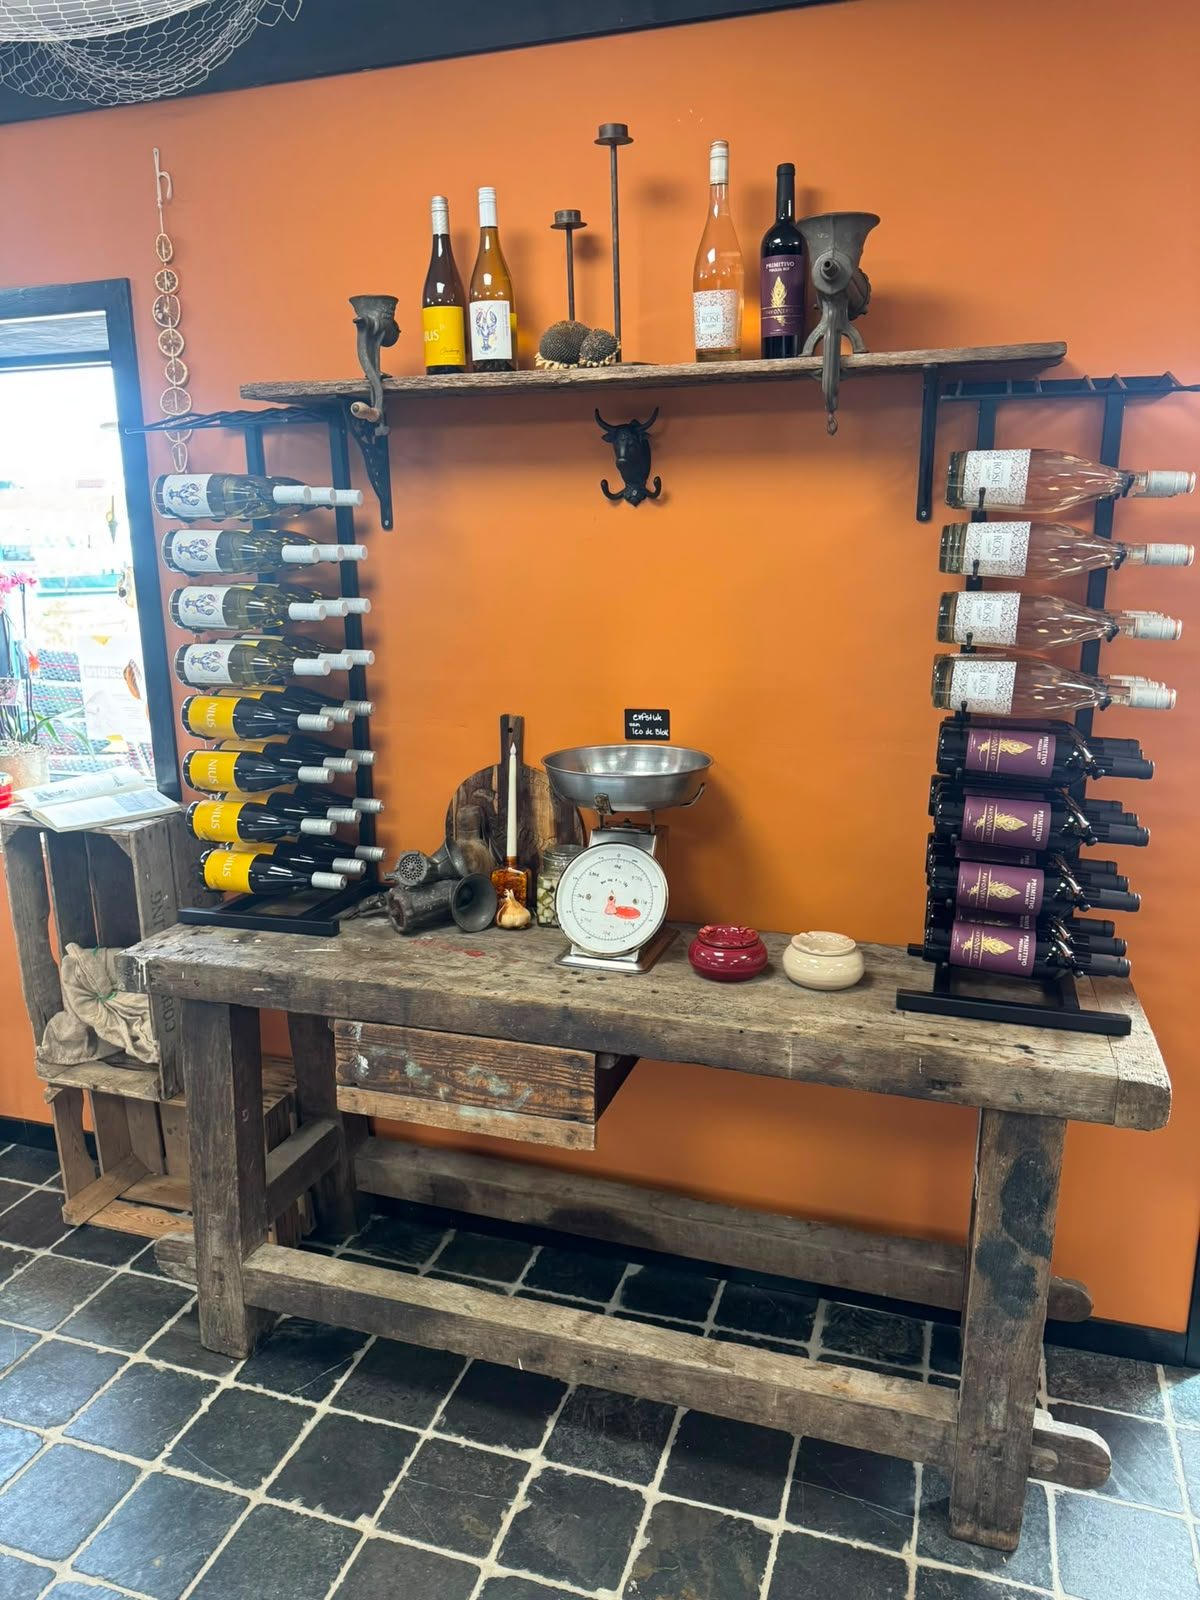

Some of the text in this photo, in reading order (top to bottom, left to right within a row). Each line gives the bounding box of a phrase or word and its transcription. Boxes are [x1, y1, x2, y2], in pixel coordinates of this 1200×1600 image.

[765, 261, 795, 269] PRIMITIVO
[1040, 736, 1049, 765] PRIMITIVO
[1035, 810, 1044, 842] PRIMITIVO
[1028, 879, 1037, 909] PRIMITIVO
[1021, 935, 1030, 966] PRIMITIVO
